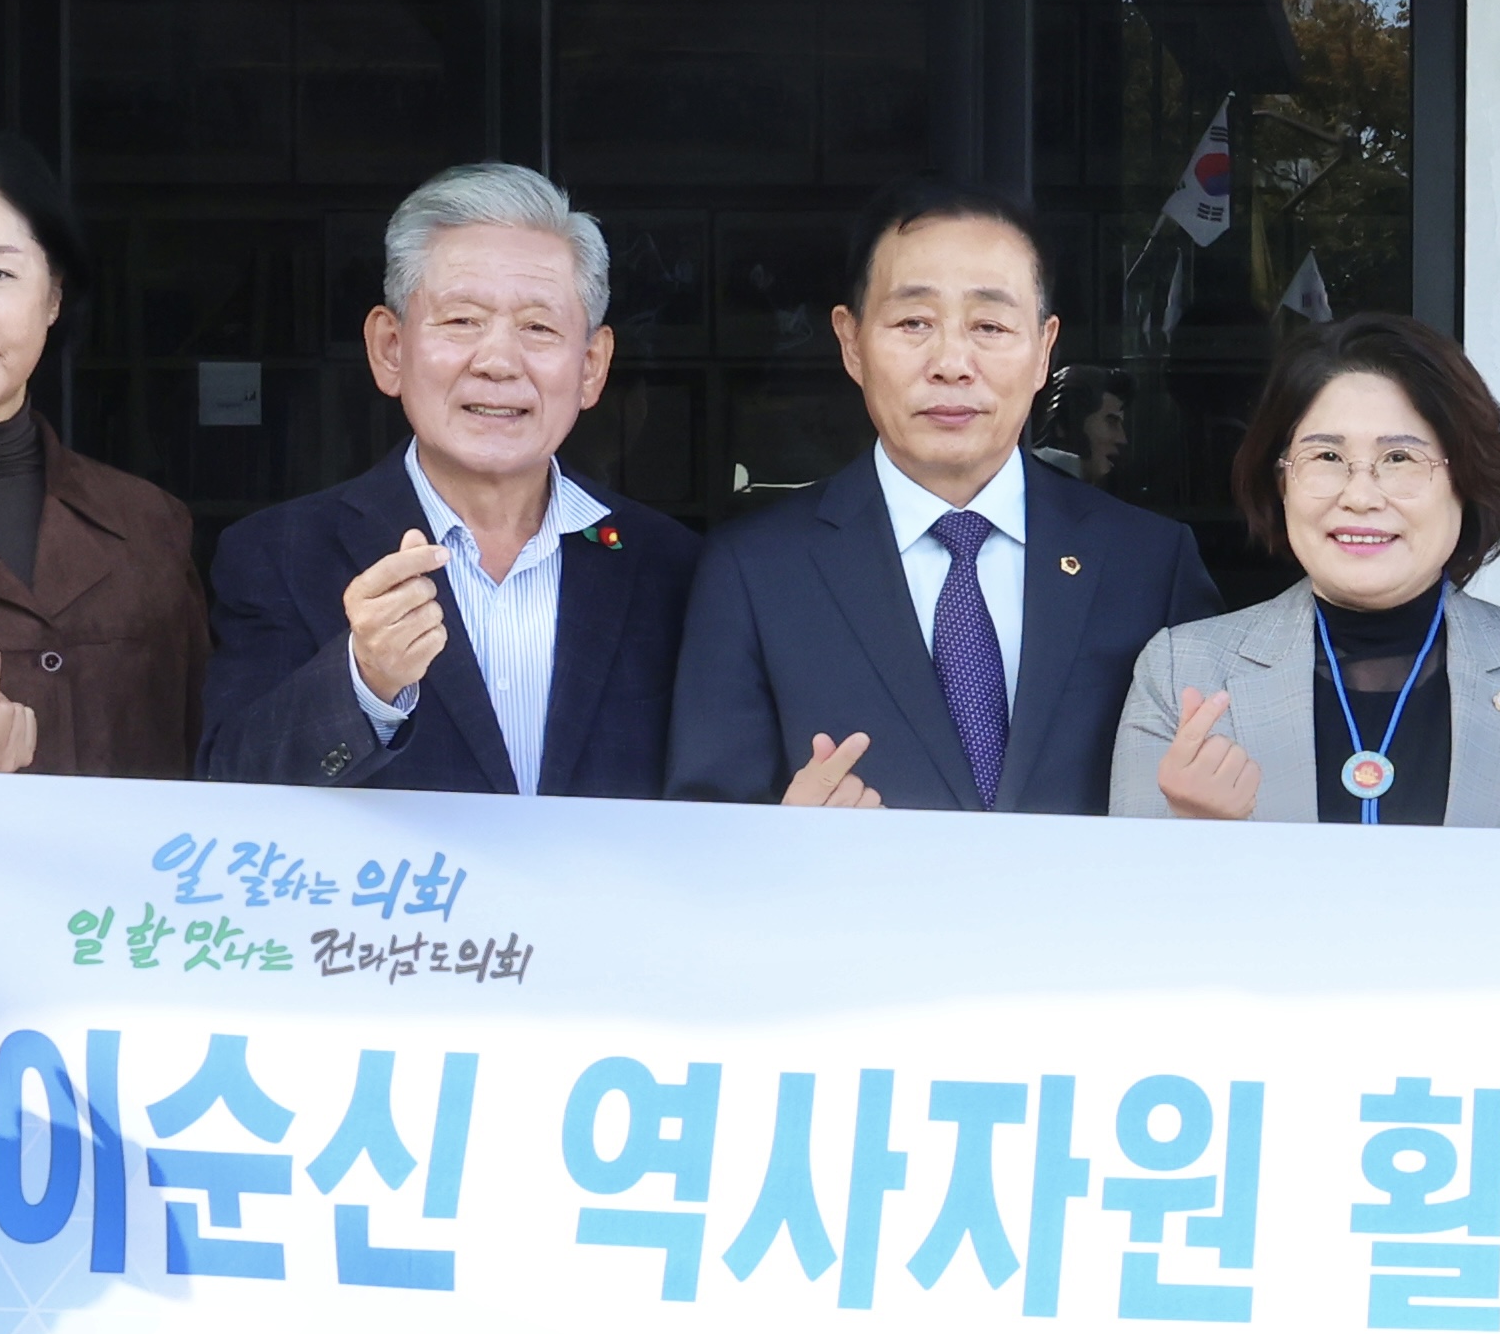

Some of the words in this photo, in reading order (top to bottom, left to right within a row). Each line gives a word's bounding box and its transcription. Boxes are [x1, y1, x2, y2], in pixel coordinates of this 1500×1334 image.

[151, 832, 224, 905] 일
[227, 840, 340, 908] 잘하는
[350, 851, 468, 922] 의회
[310, 927, 534, 985] 전라남도의회
[559, 1054, 1266, 1324] 역사자원
